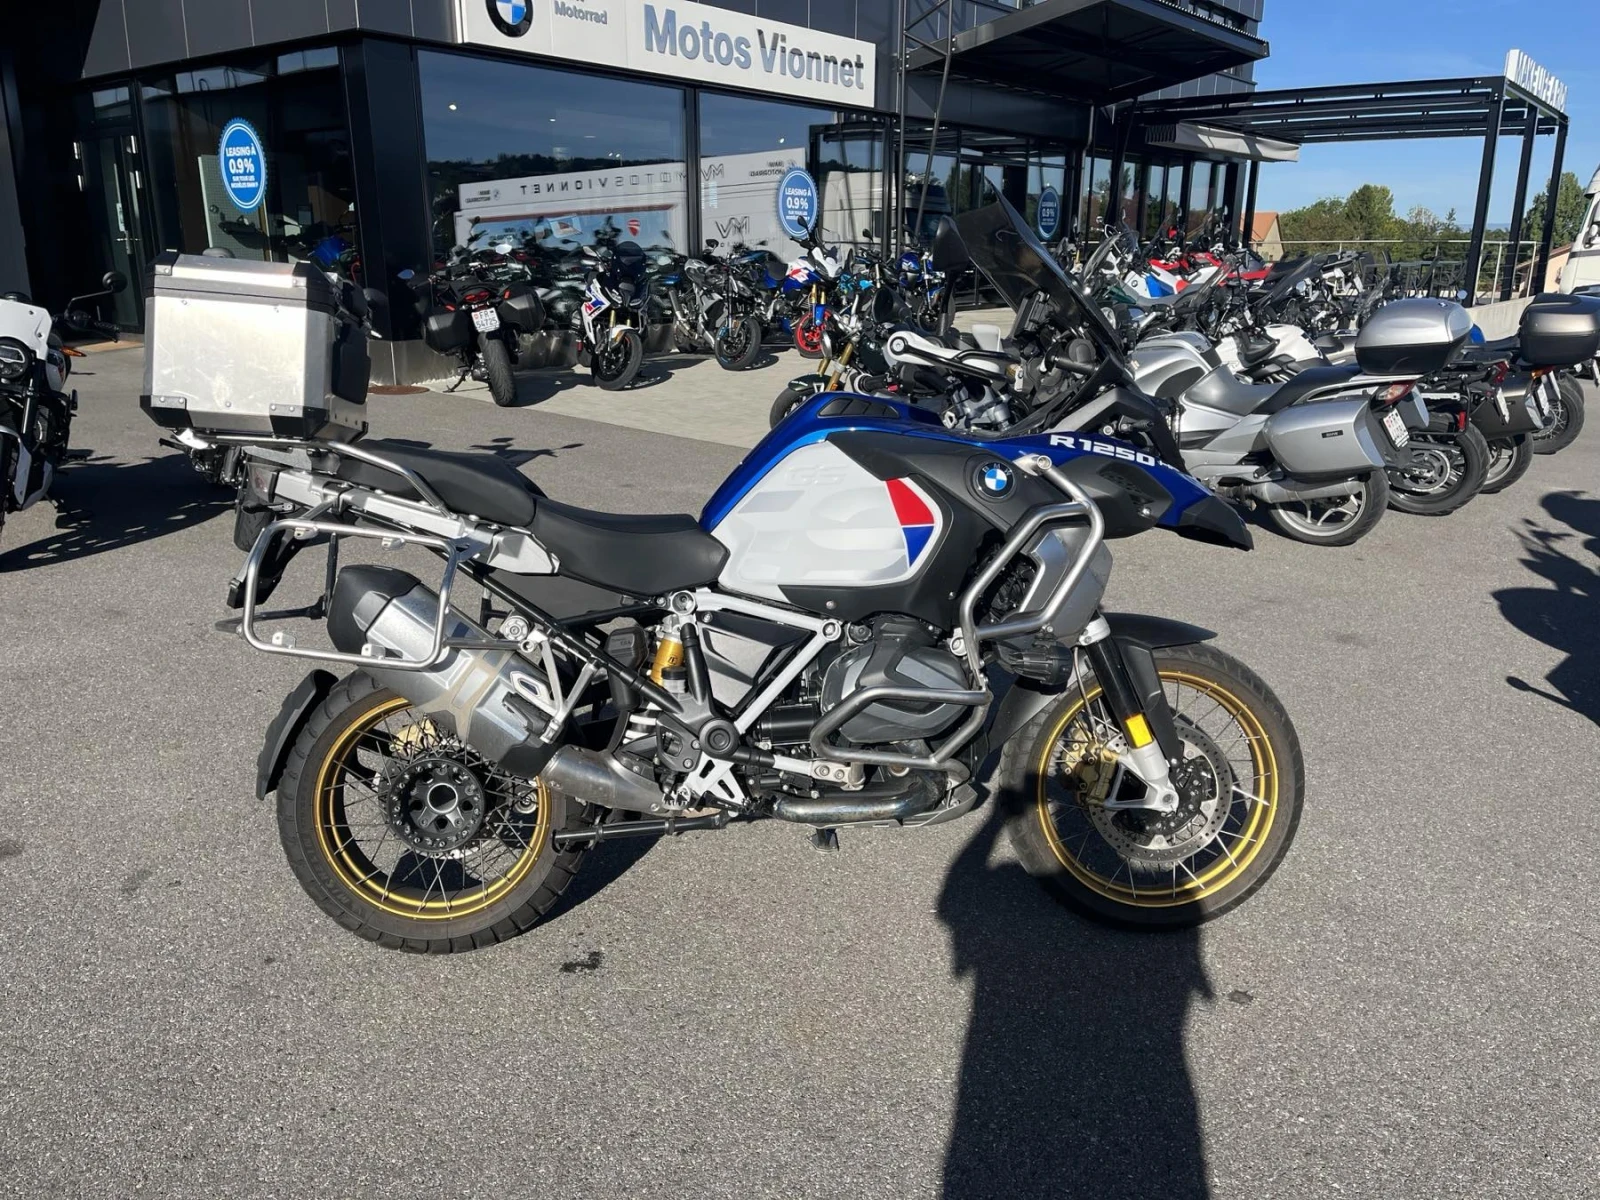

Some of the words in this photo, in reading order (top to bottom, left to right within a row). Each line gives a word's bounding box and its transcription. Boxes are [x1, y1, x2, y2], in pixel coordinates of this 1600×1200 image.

[554, 0, 608, 25] Motorrad
[643, 3, 752, 70] Motos
[756, 28, 865, 90] Vionnet
[226, 146, 251, 156] LEASING
[251, 143, 256, 155] À
[785, 187, 807, 196] LEASING
[807, 187, 811, 196] À
[1050, 434, 1076, 449] R
[1078, 438, 1156, 467] 1250
[981, 462, 1013, 476] BMW
